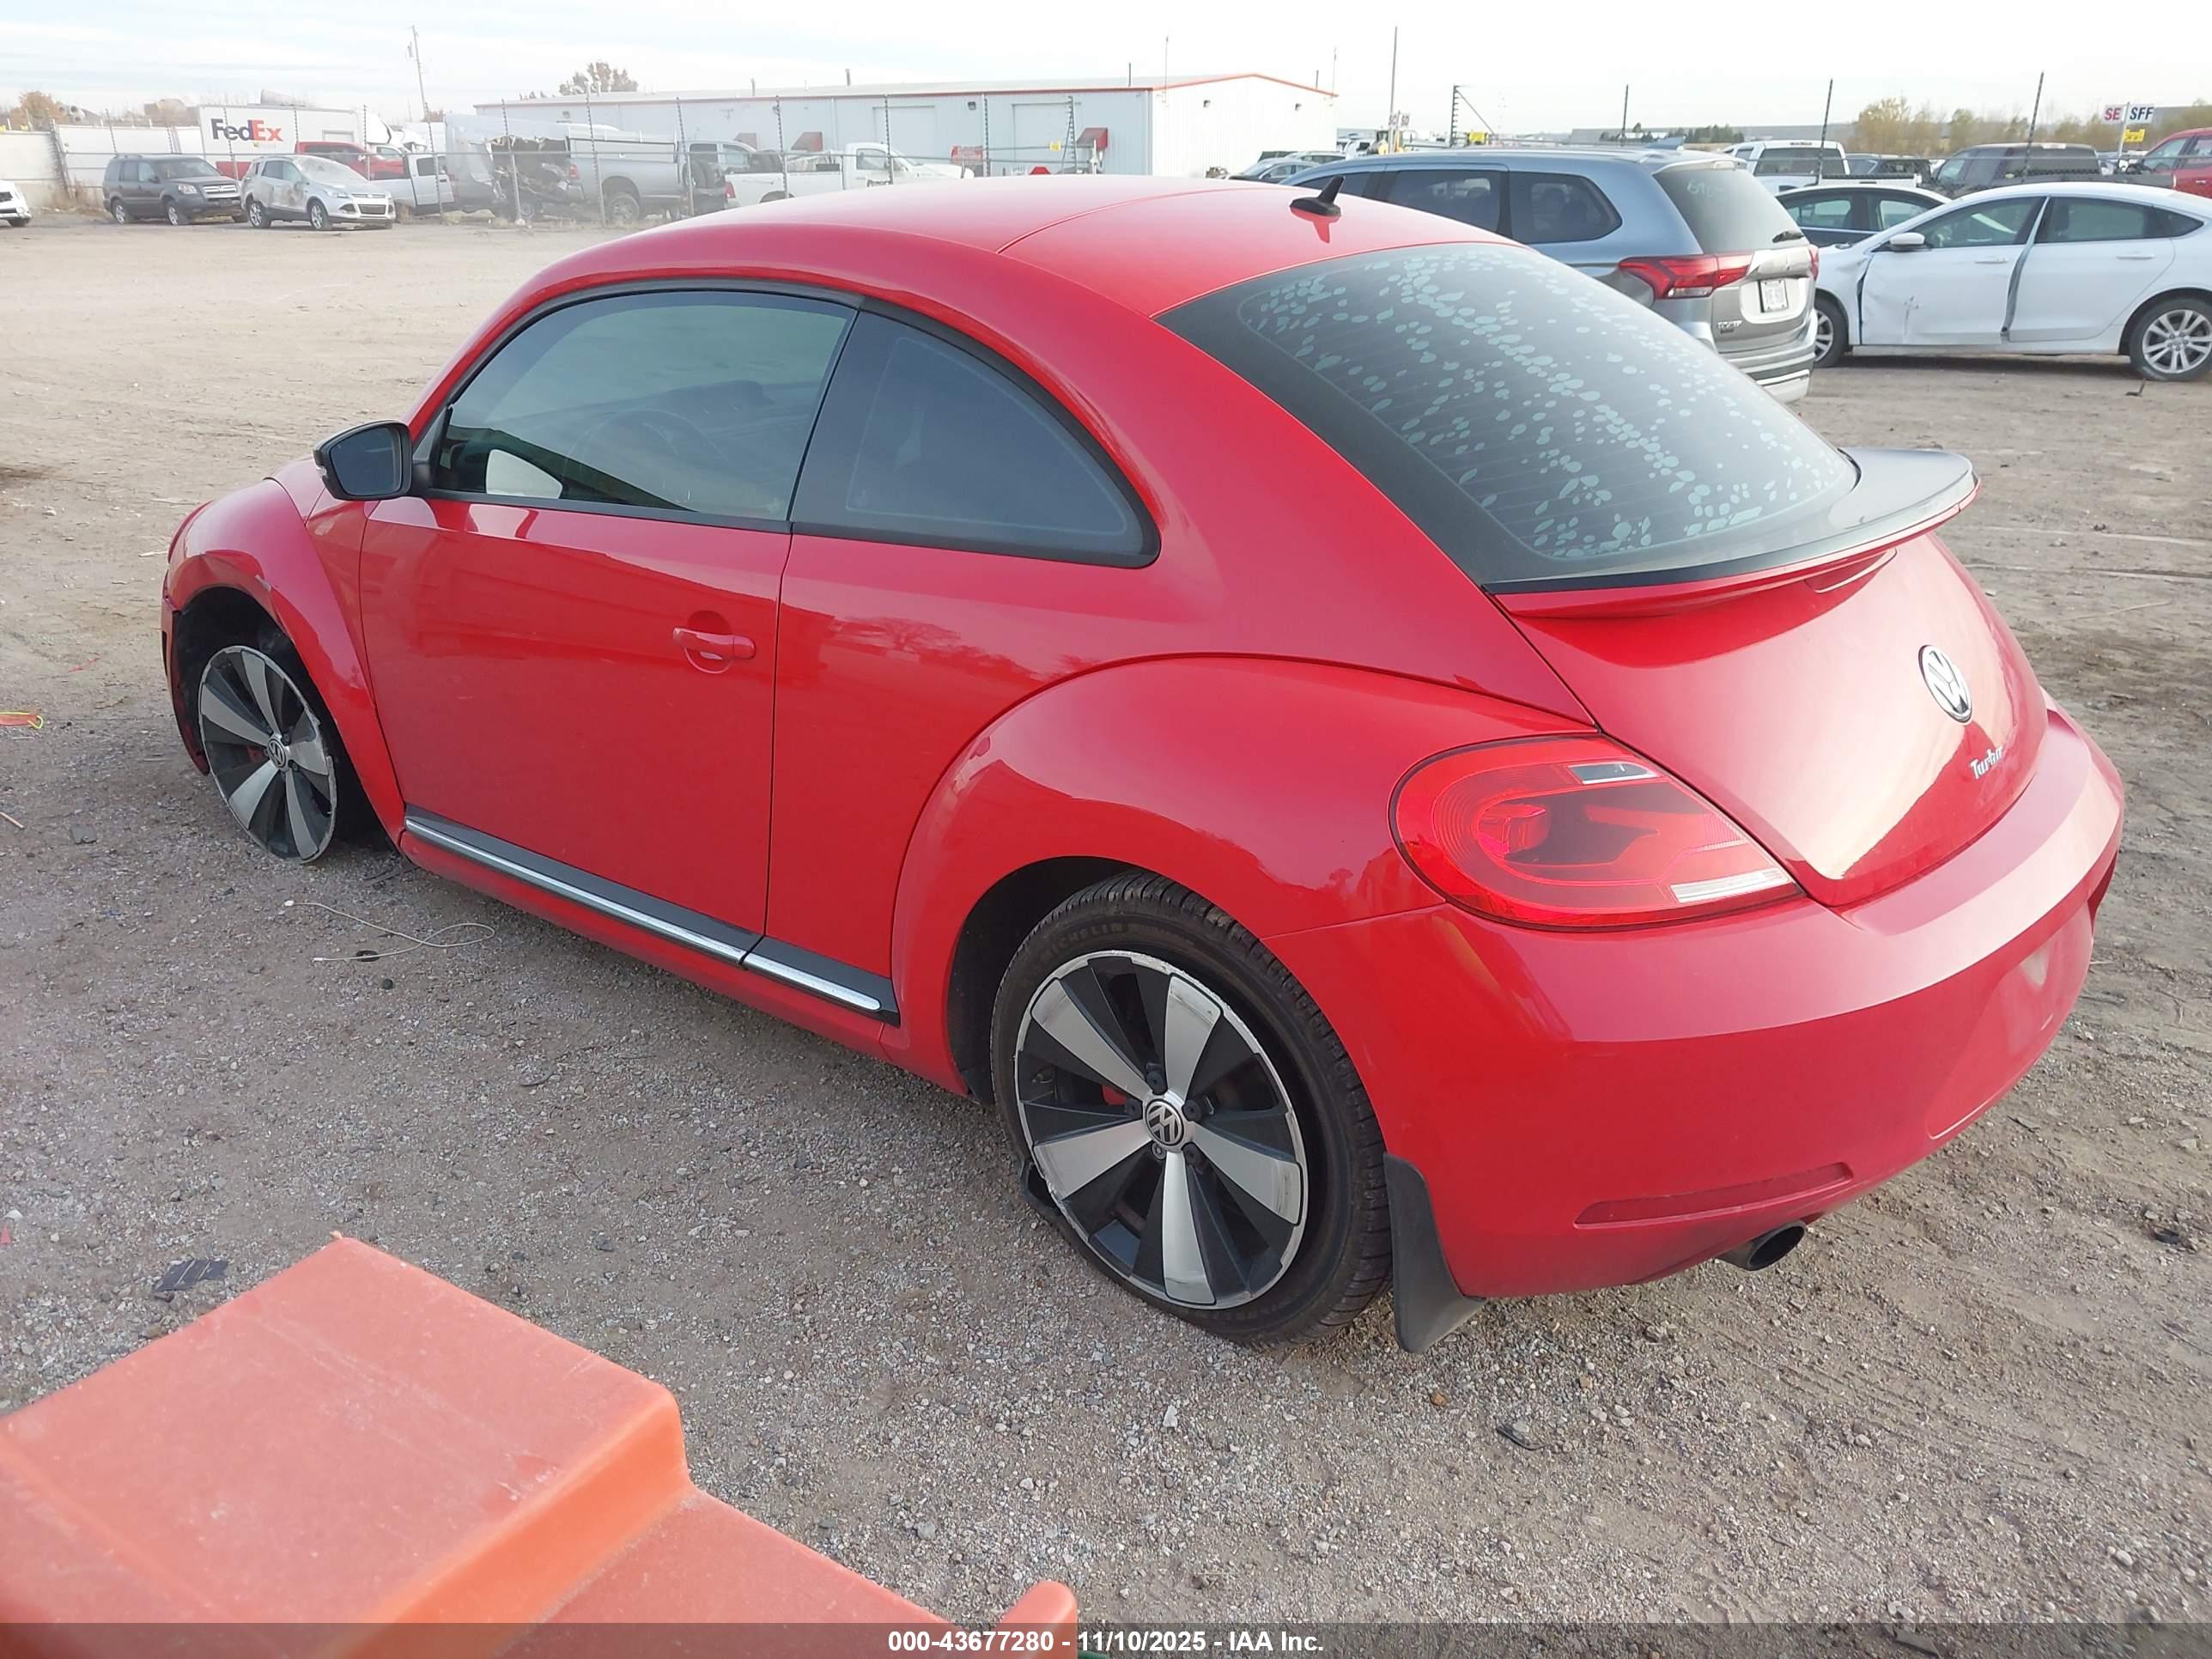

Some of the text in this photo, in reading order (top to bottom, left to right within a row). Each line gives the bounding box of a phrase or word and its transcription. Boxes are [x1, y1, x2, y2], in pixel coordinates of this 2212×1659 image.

[2130, 106, 2154, 120] SFF
[210, 118, 283, 142] FedEx
[1970, 745, 2002, 779] Turbo
